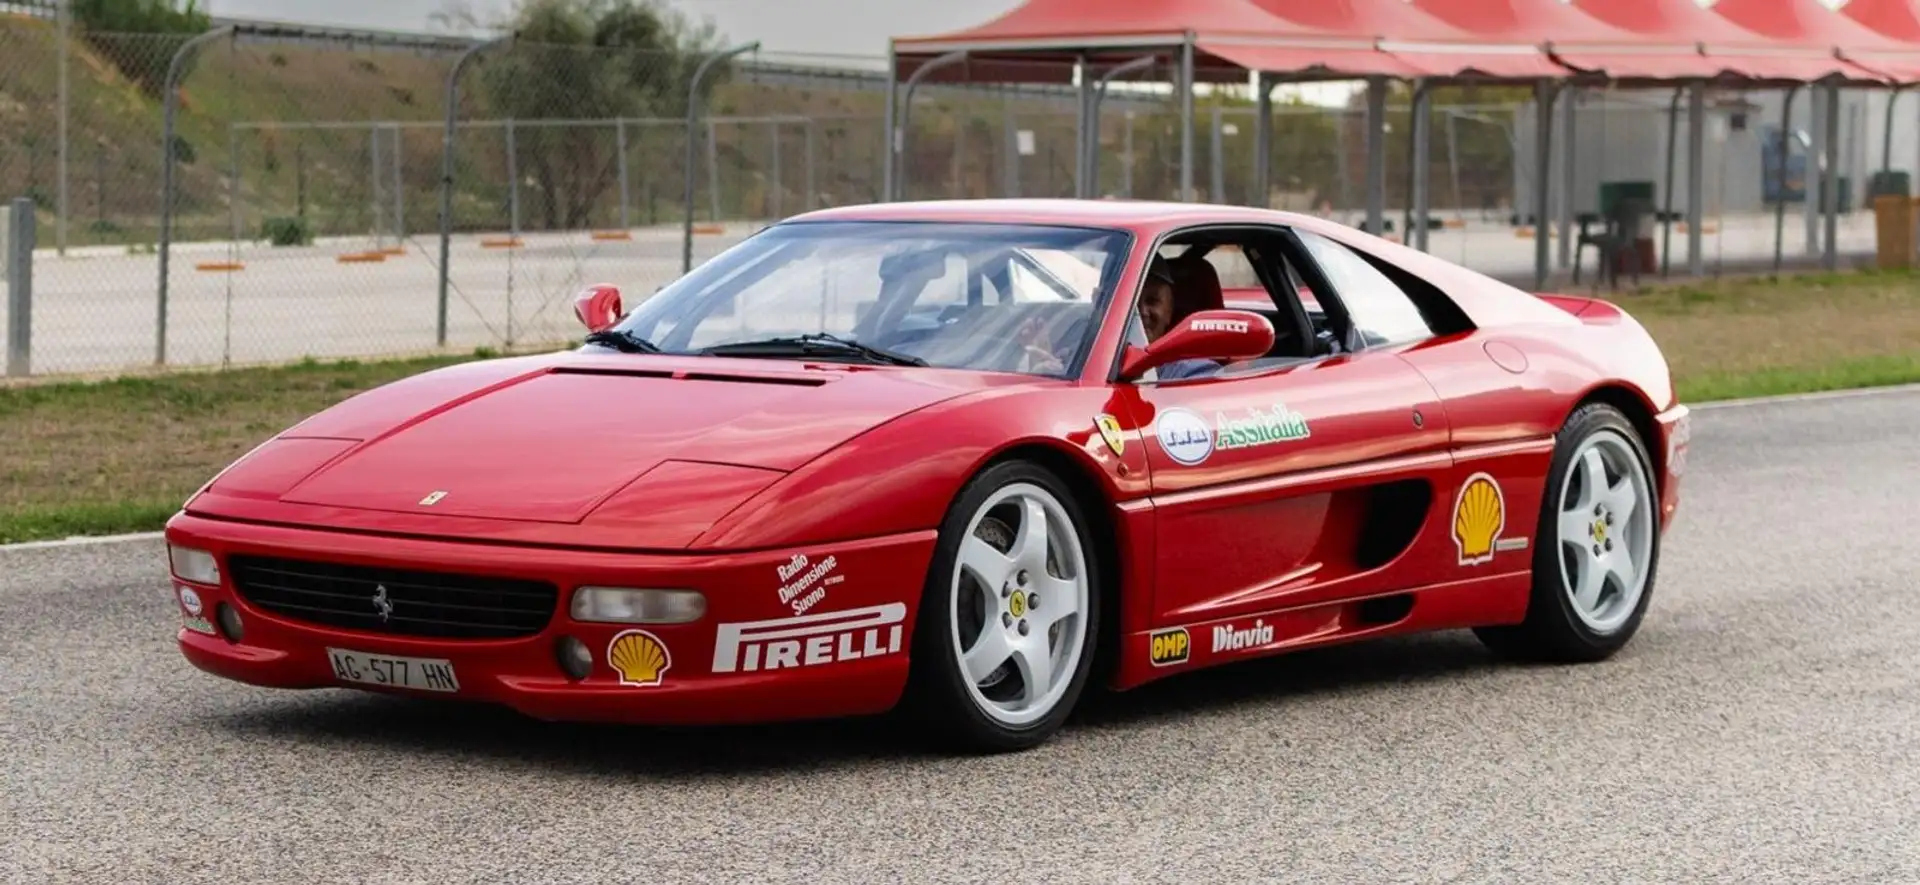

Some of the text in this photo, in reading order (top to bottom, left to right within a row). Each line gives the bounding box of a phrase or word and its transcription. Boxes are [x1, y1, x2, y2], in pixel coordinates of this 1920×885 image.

[1216, 405, 1309, 448] Assitalia
[777, 554, 808, 582] Radio
[778, 555, 837, 605] Dimensione
[791, 586, 826, 616] Suono
[711, 602, 907, 673] PIRELLI
[1153, 632, 1188, 660] OMP
[1212, 619, 1274, 653] Diavia
[421, 663, 456, 690] HN
